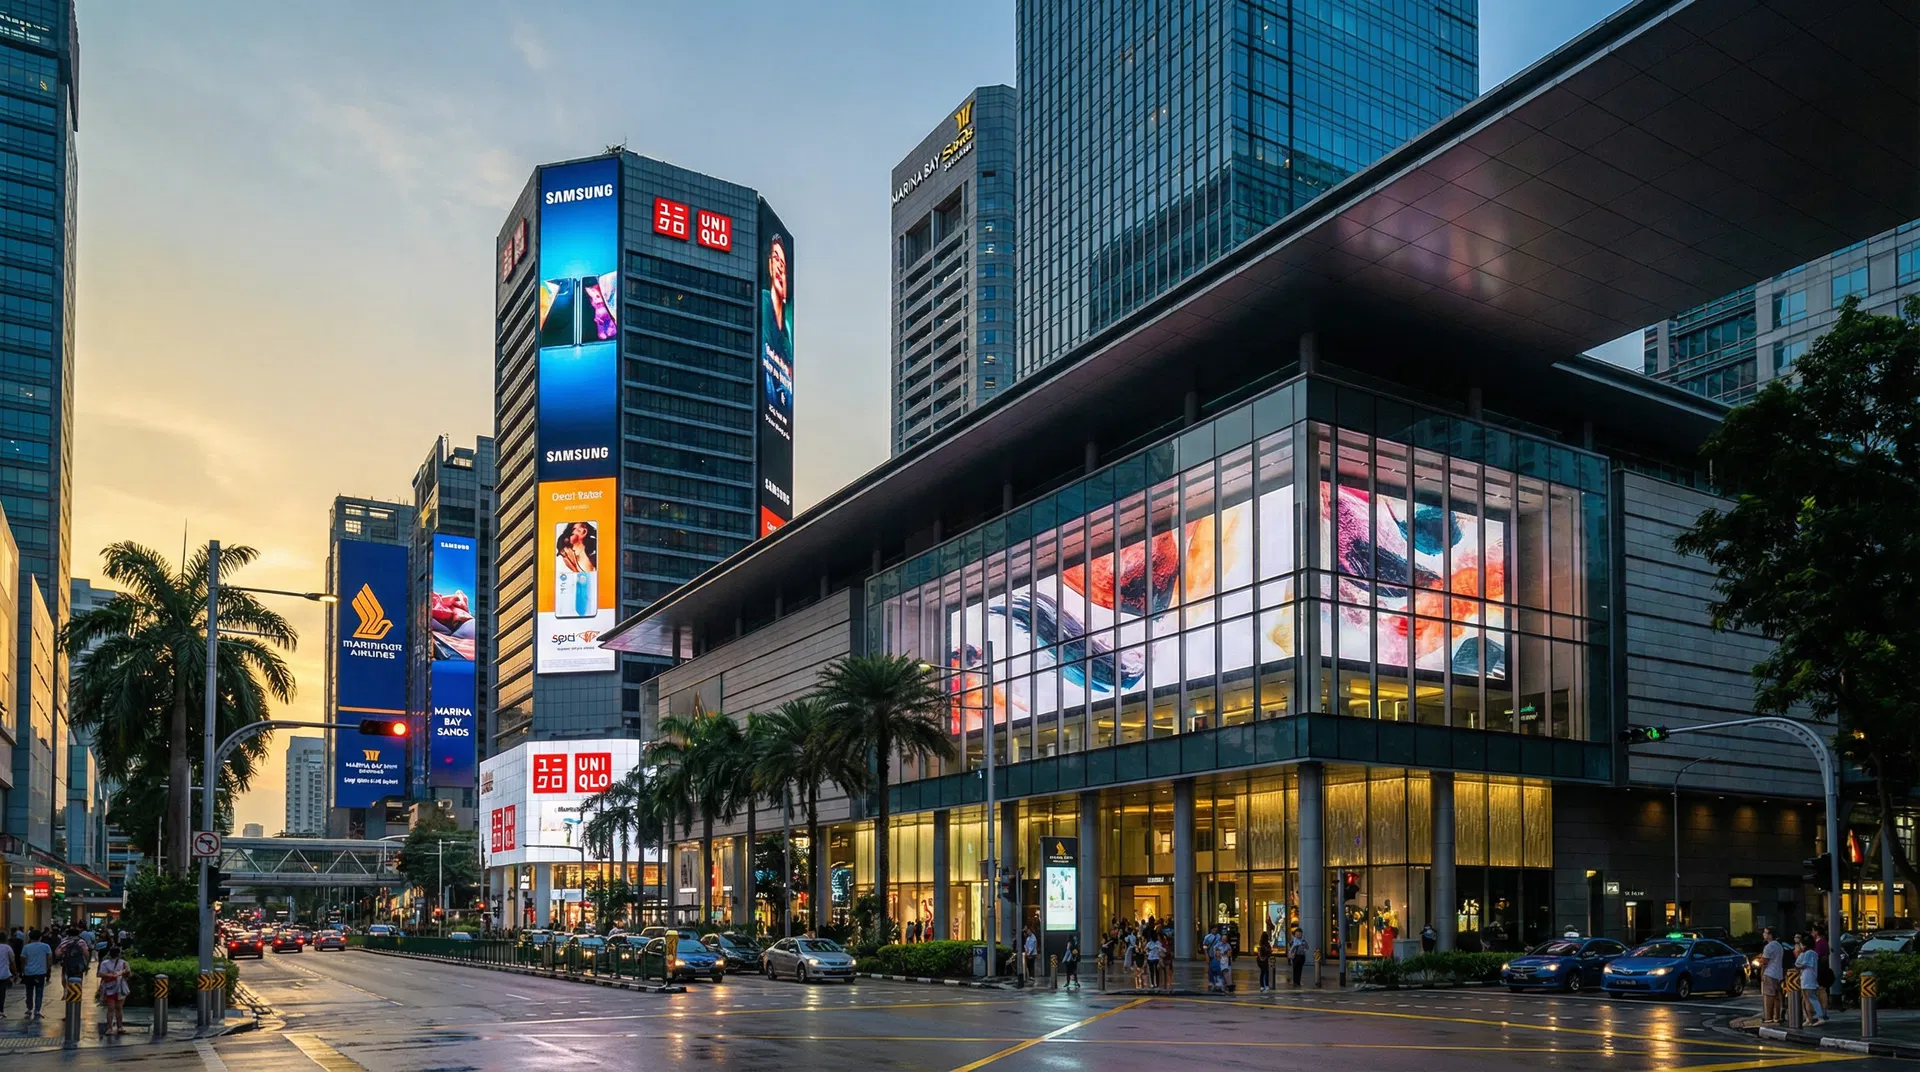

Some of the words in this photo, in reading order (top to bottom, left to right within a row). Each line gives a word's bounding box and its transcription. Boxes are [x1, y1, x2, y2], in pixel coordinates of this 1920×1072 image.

[545, 183, 613, 205] SAMSUNG
[701, 213, 726, 233] UNI
[701, 229, 729, 246] QLO
[546, 446, 609, 463] SAMSUNG
[350, 649, 396, 660] AIRLINES
[434, 706, 473, 717] MARINA
[444, 717, 462, 727] BAY
[437, 727, 470, 737] SANDS
[580, 757, 608, 771] UNI
[580, 773, 610, 790] QLO
